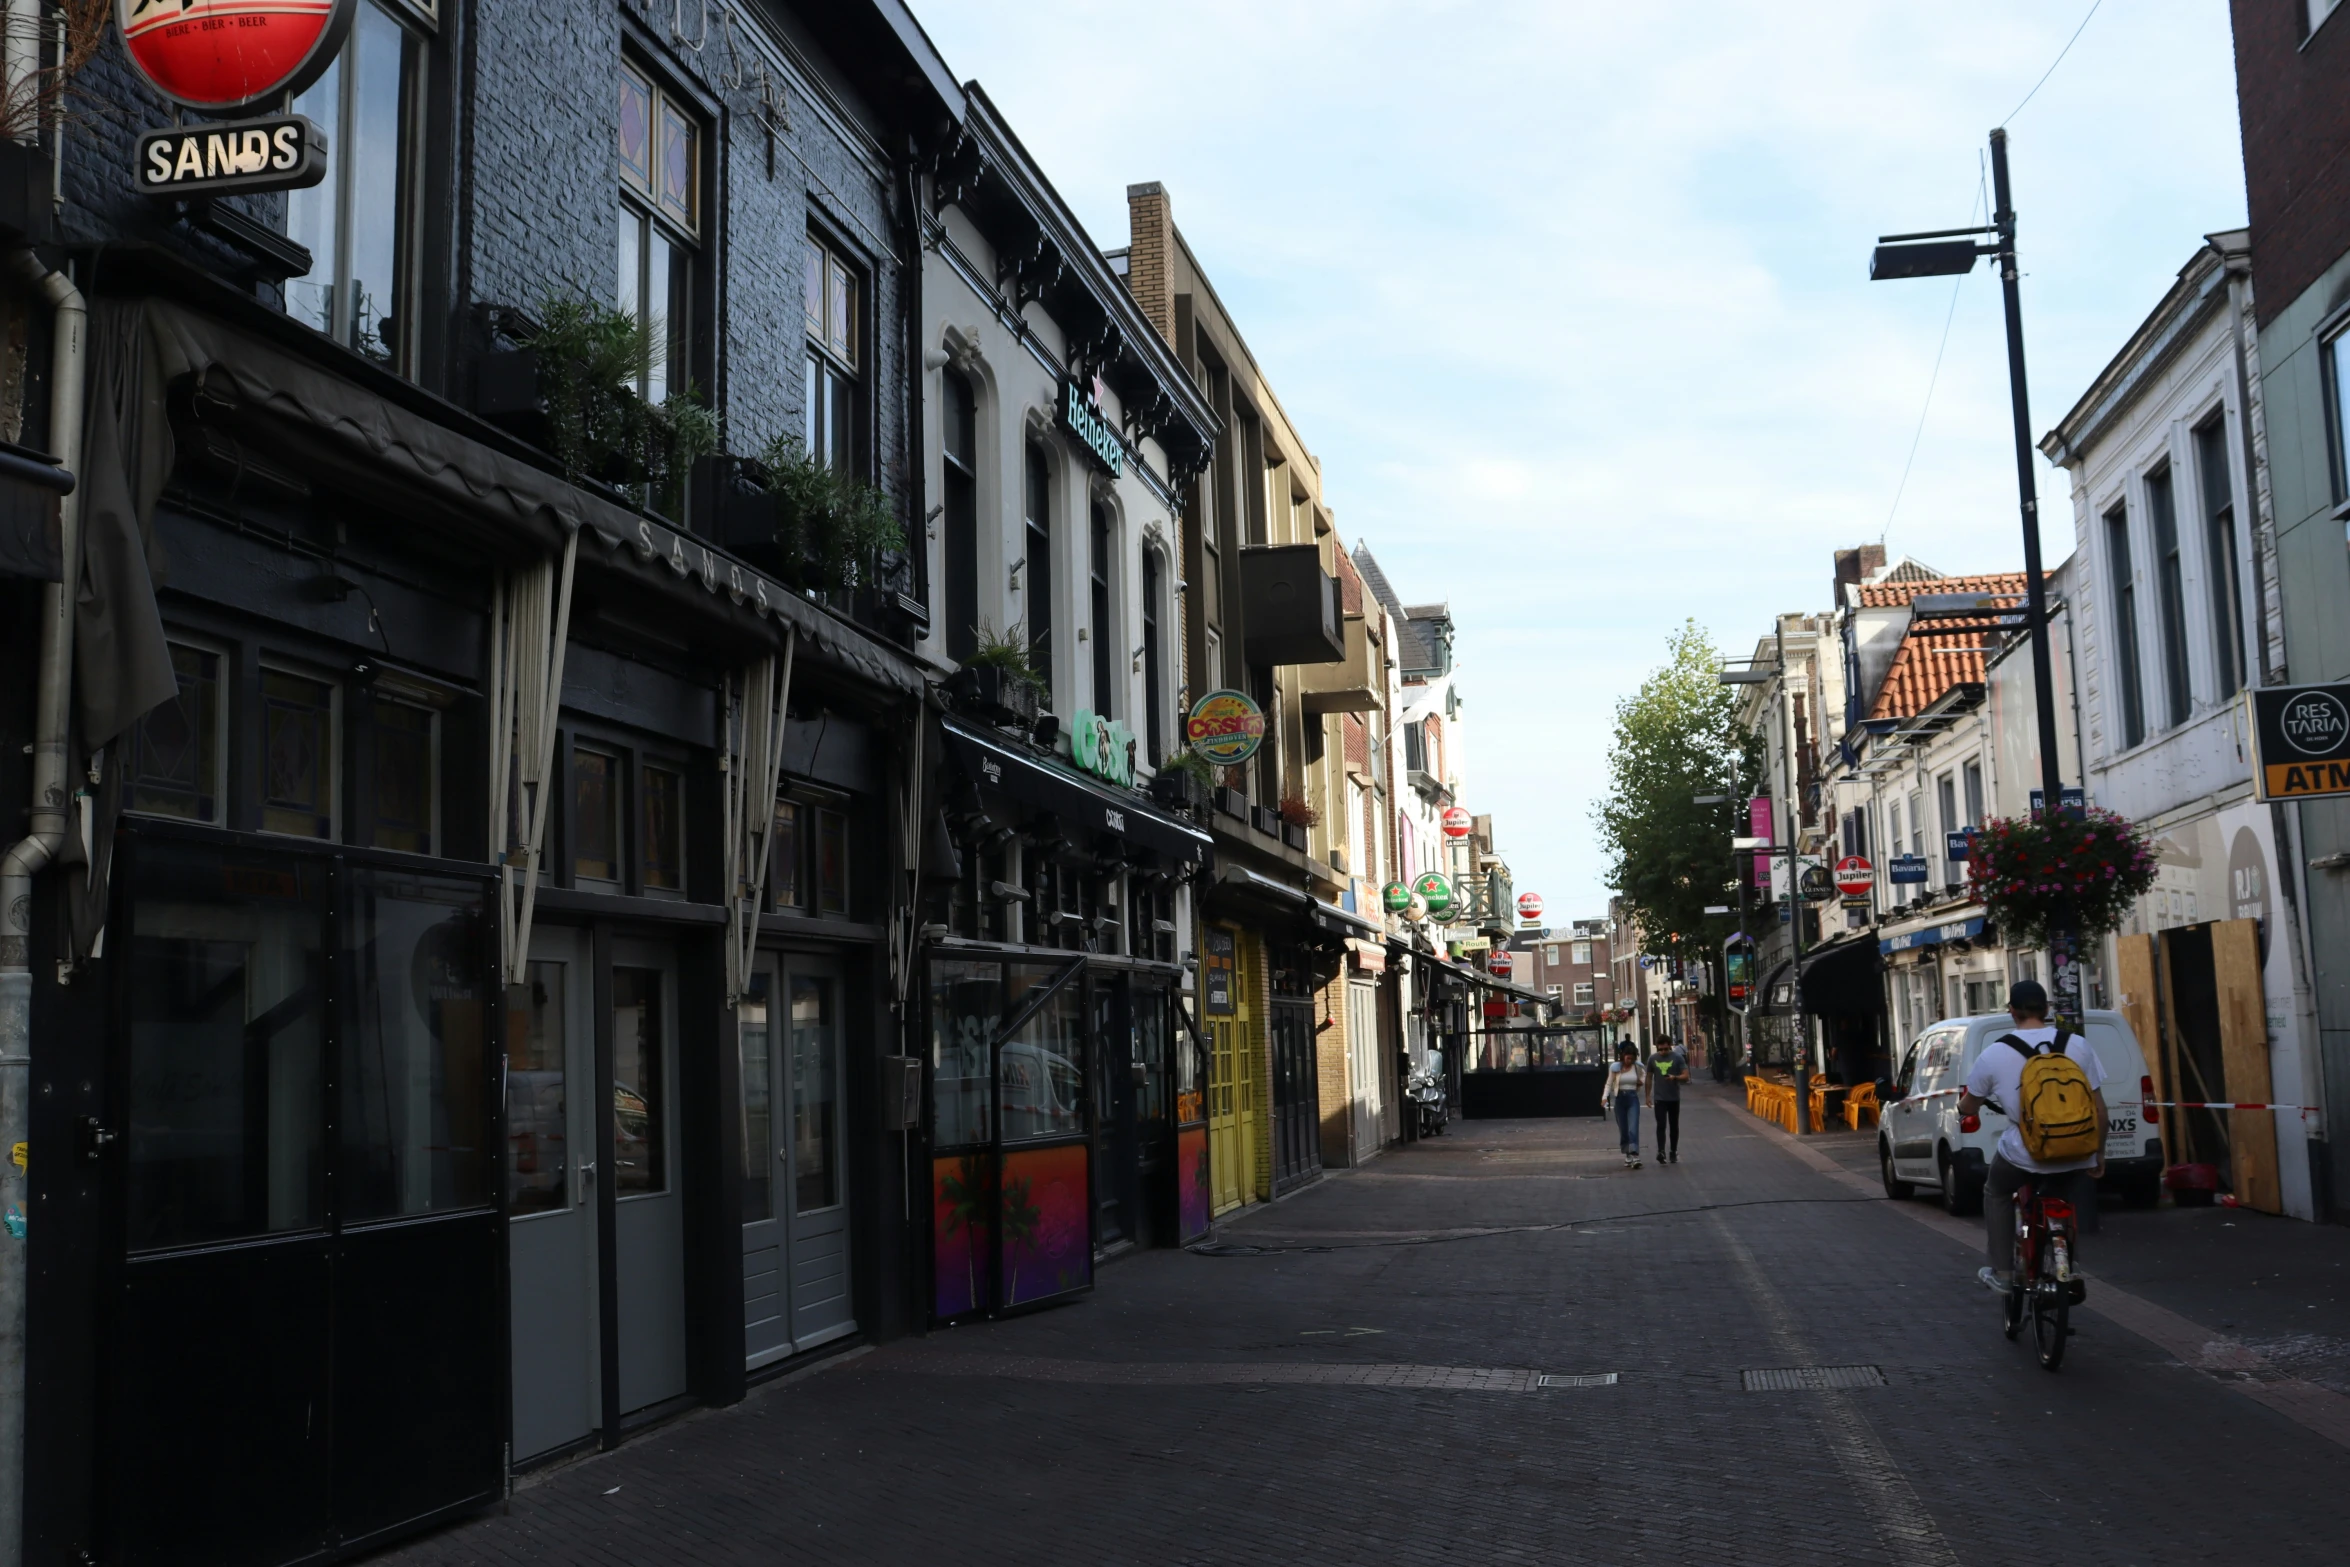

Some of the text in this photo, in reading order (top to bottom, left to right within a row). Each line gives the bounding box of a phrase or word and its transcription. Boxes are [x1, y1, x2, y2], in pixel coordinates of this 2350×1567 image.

[201, 18, 226, 32] BIER
[238, 16, 267, 28] BEER
[146, 125, 299, 184] SANDS
[1067, 381, 1124, 480] Heineken
[2295, 702, 2332, 719] RES
[2287, 717, 2344, 735] TARIA
[1206, 733, 1247, 745] EINDHOVEN
[2284, 762, 2350, 793] ATM
[1444, 819, 1469, 827] Jupiler
[1891, 864, 1927, 873] Bavaria
[1837, 871, 1873, 882] Jupiler
[2234, 867, 2251, 901] RJ
[1518, 902, 1541, 910] Jupiler
[1550, 925, 1590, 937] Bavaria
[2108, 1118, 2137, 1132] NXS
